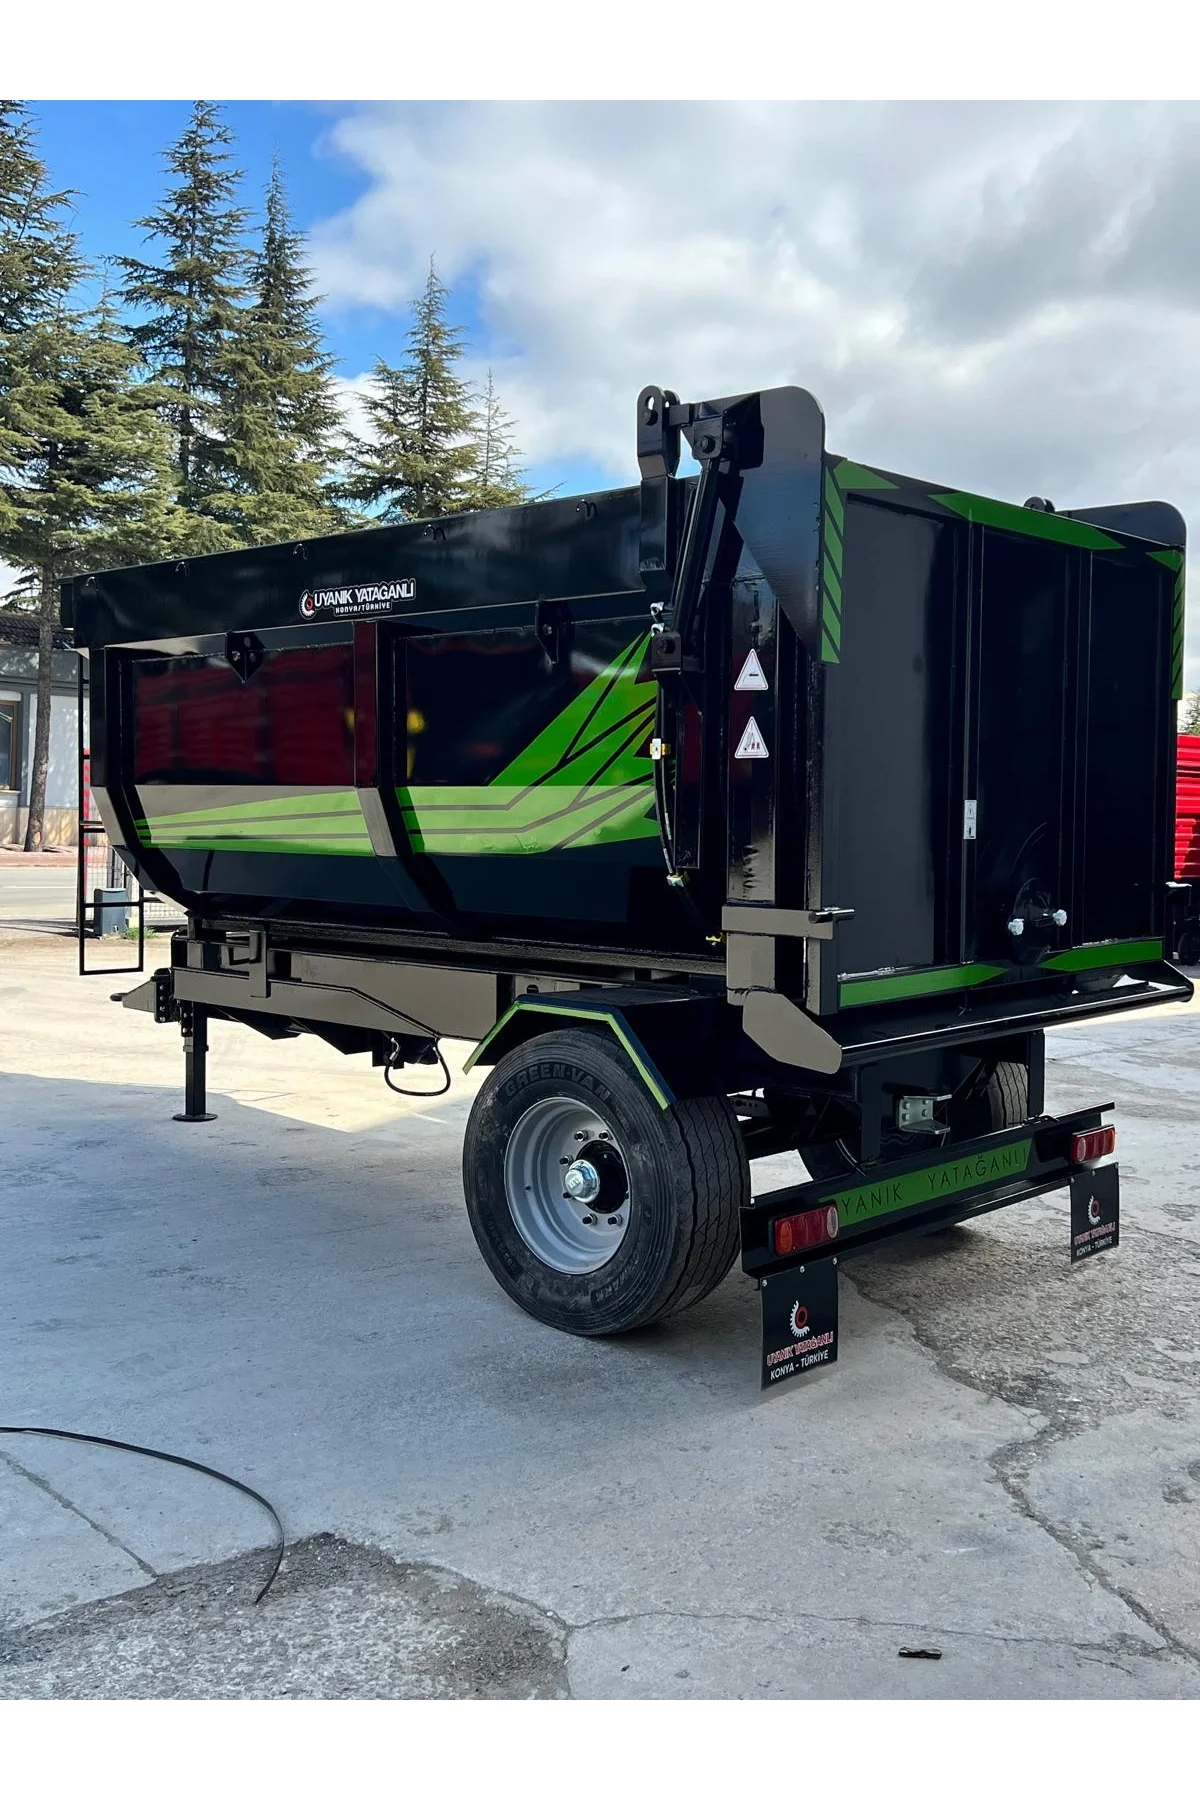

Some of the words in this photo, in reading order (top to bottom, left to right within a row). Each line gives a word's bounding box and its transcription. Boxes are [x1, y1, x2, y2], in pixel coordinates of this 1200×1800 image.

[314, 589, 353, 607] UYANIK
[842, 1182, 903, 1215] YANIK
[927, 1148, 1026, 1192] YATAĞANLI
[770, 1363, 795, 1381] KONYA
[801, 1349, 829, 1368] TÜRKİYE
